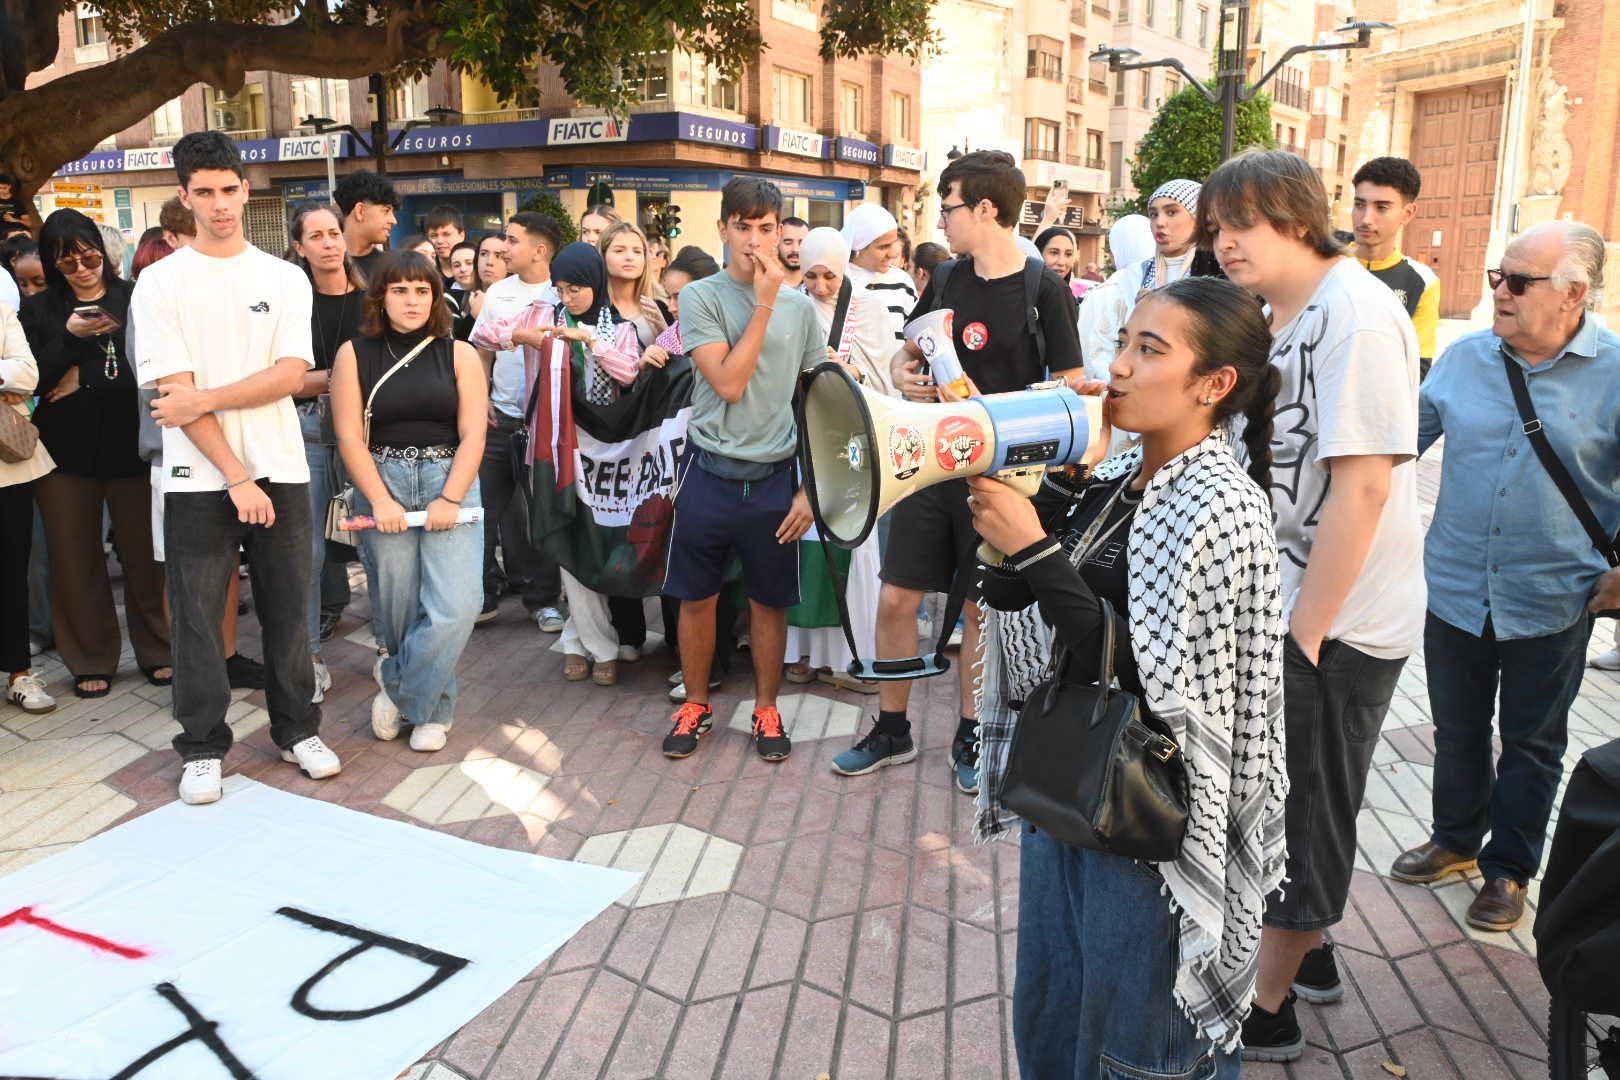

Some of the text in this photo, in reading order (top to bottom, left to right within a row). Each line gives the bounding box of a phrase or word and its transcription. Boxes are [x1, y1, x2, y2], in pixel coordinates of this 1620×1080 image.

[553, 121, 603, 140] FIATC
[689, 124, 746, 144] SEGUROS
[283, 140, 320, 157] FIATC
[395, 134, 473, 151] EGUROS
[782, 132, 808, 151] FIATC
[127, 152, 158, 166] FIATC
[842, 145, 877, 162] SEGUROS
[67, 158, 122, 172] SEGUROS
[839, 296, 858, 359] ALESTINE
[580, 453, 630, 497] REE
